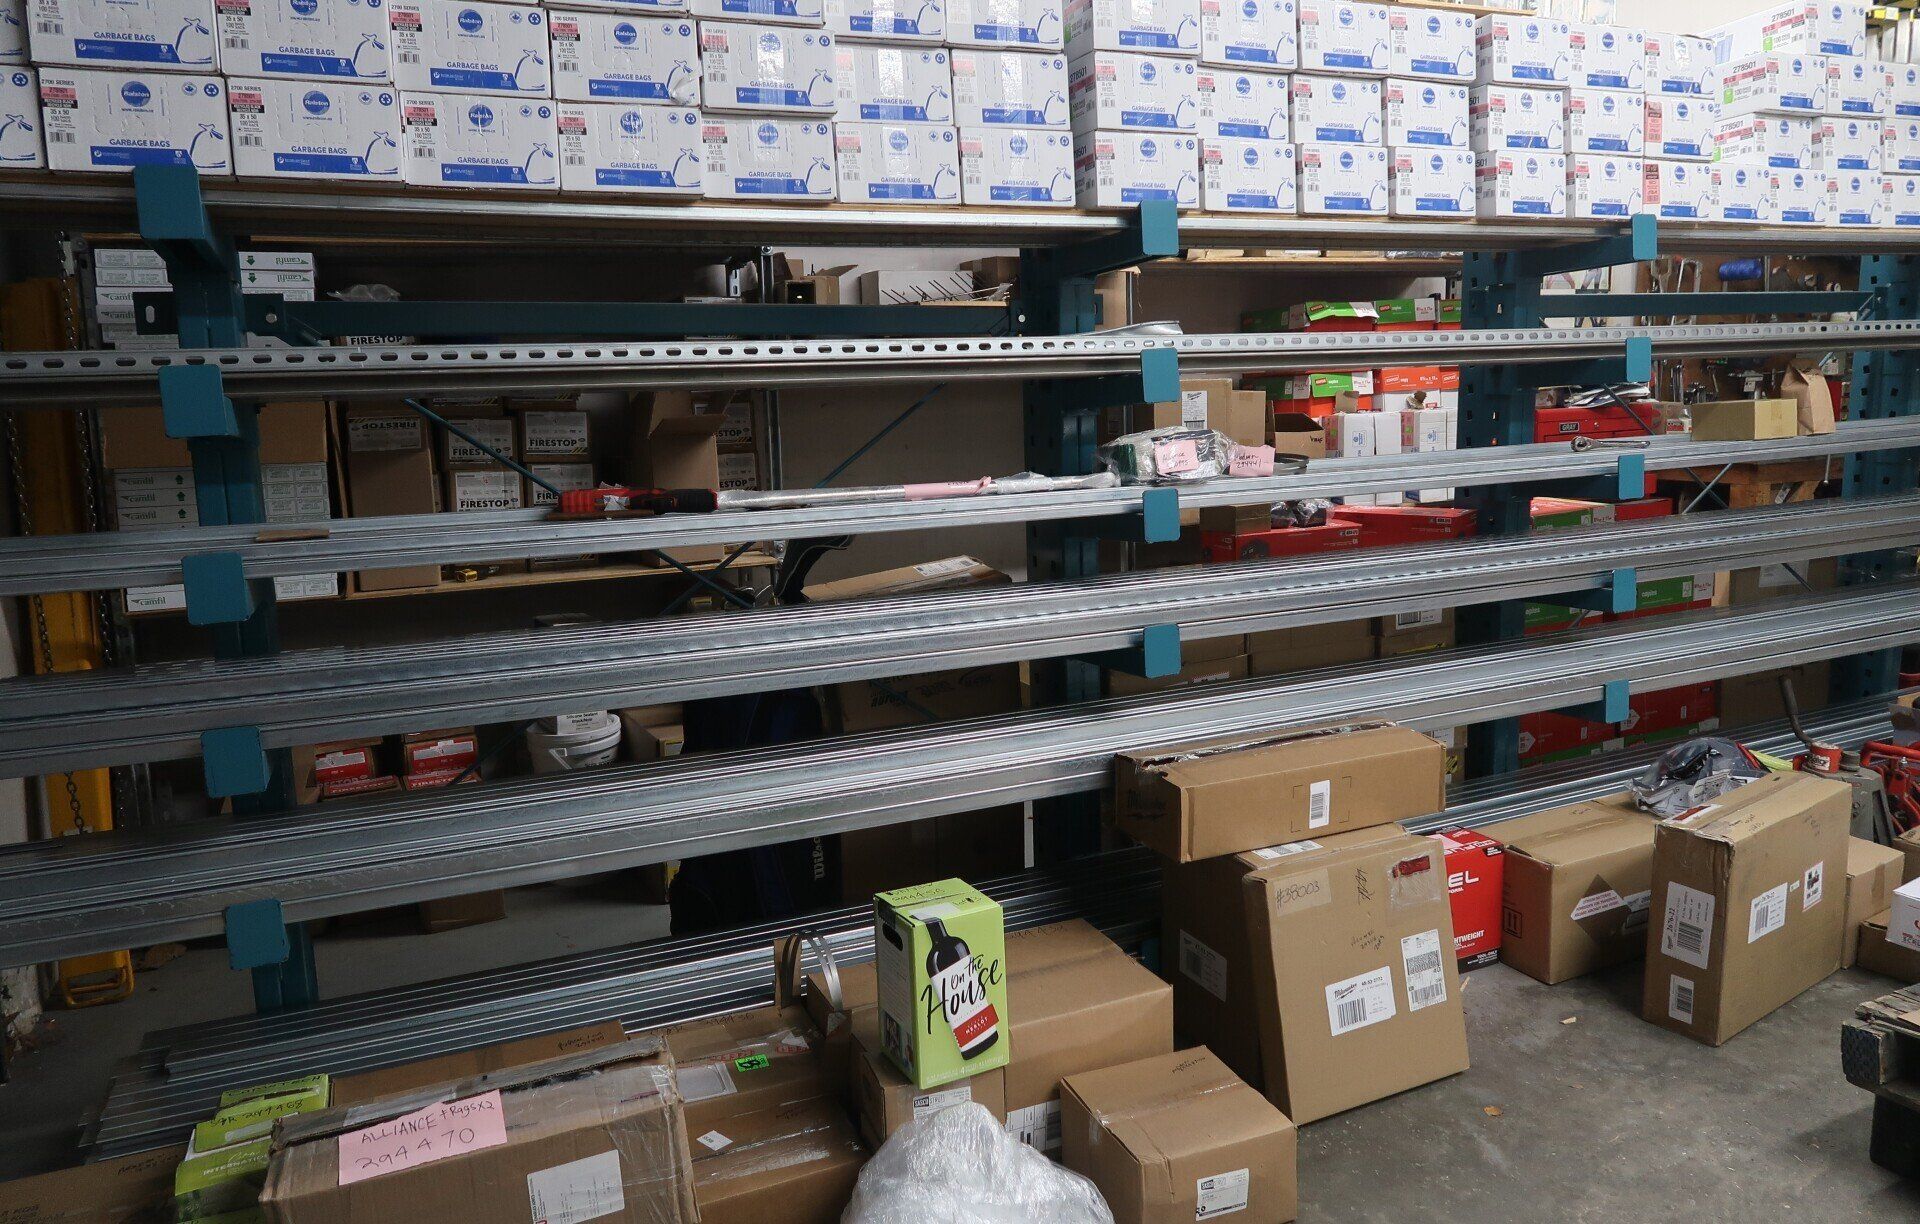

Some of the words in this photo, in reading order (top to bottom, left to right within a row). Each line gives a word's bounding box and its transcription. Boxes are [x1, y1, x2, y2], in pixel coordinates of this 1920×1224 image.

[1772, 8, 1795, 21] 278501
[460, 17, 482, 25] Ralston
[93, 31, 133, 40] GARBAGE
[134, 33, 156, 42] BAGS
[279, 46, 314, 55] GARBAGE
[316, 48, 335, 56] BAGS
[1733, 61, 1756, 73] 278501
[305, 99, 329, 107] Ralston
[1721, 120, 1744, 132] 278501
[109, 139, 148, 147] GARBAGE
[110, 293, 133, 301] camf
[351, 335, 402, 345] FIRESTOP
[362, 421, 417, 429] FIRESTOP
[716, 429, 742, 437] STOP
[529, 439, 577, 447] FIRESTOP
[127, 476, 154, 487] camfil
[720, 479, 748, 488] ESTOP
[129, 492, 156, 503] camfil
[537, 492, 558, 500] FIRE
[460, 500, 509, 508] FIRESTOP
[130, 509, 157, 521] camfil
[140, 595, 166, 606] camfil
[1448, 870, 1479, 888] EL
[1454, 930, 1485, 944] HTWEIGHT
[951, 974, 965, 990] On
[964, 954, 984, 975] the
[920, 959, 1002, 1035] House
[361, 1113, 437, 1144] ALLIANCE
